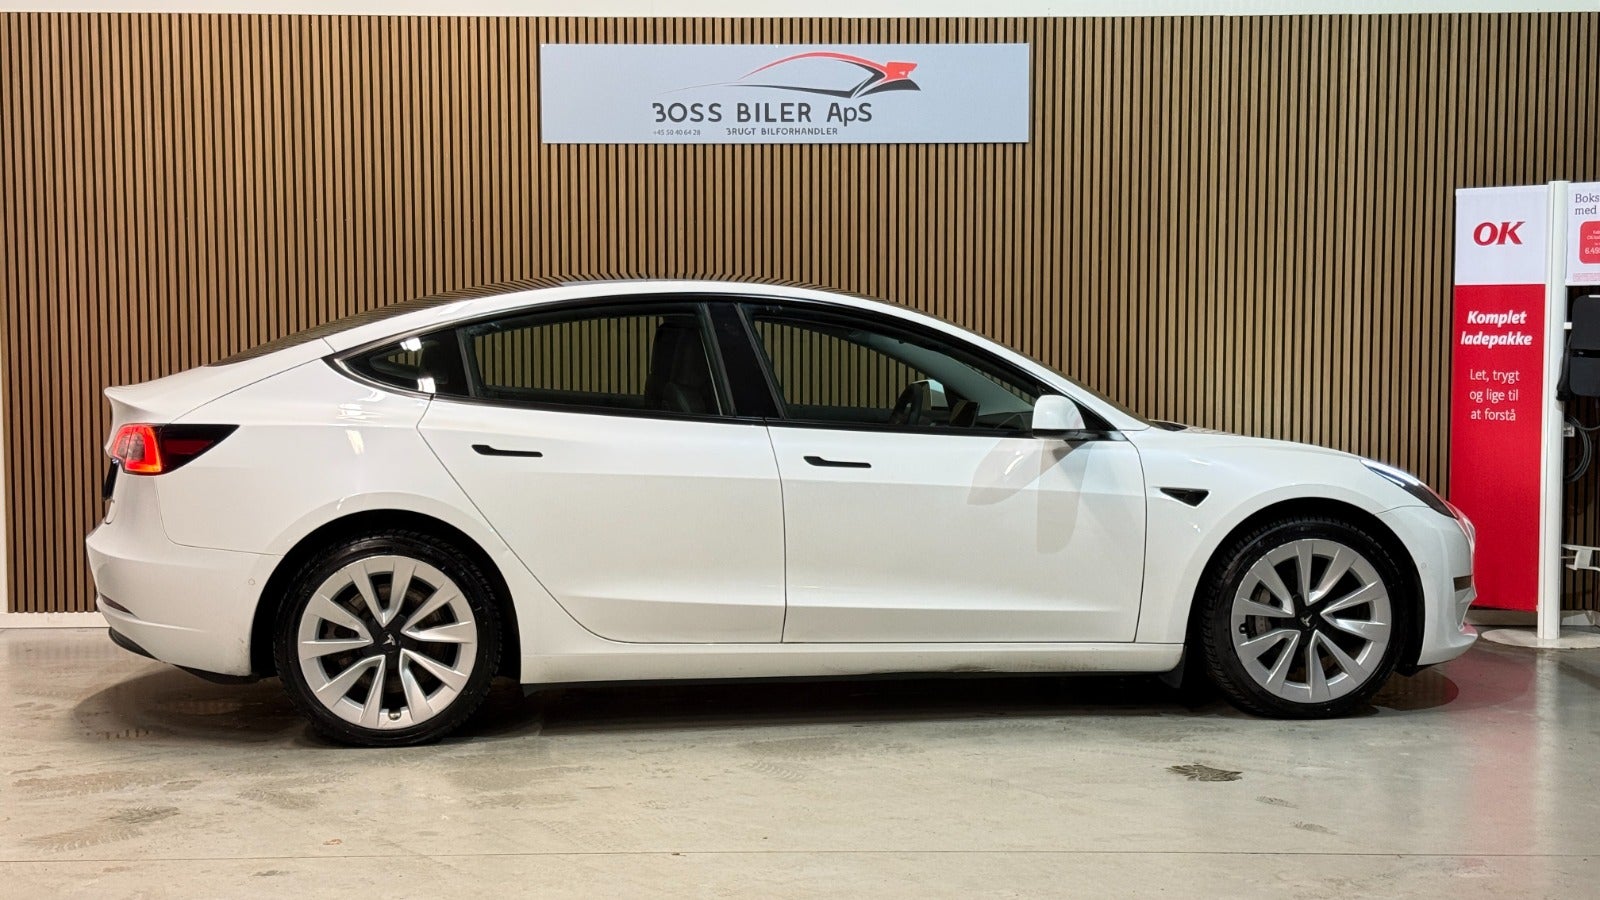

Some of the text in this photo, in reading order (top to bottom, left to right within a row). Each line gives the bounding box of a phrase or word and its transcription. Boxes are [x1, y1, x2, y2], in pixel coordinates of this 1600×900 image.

[652, 102, 873, 127] BOSS BILER ApS
[726, 127, 838, 136] BRUGT BILFORHANDLER
[1575, 205, 1597, 215] med
[1473, 221, 1526, 246] OK
[1467, 310, 1527, 328] Komplet
[1461, 331, 1533, 349] ladepakke
[1470, 369, 1520, 384] Let, trygt
[1470, 388, 1519, 404] og lige til
[1471, 407, 1516, 421] at forstå
